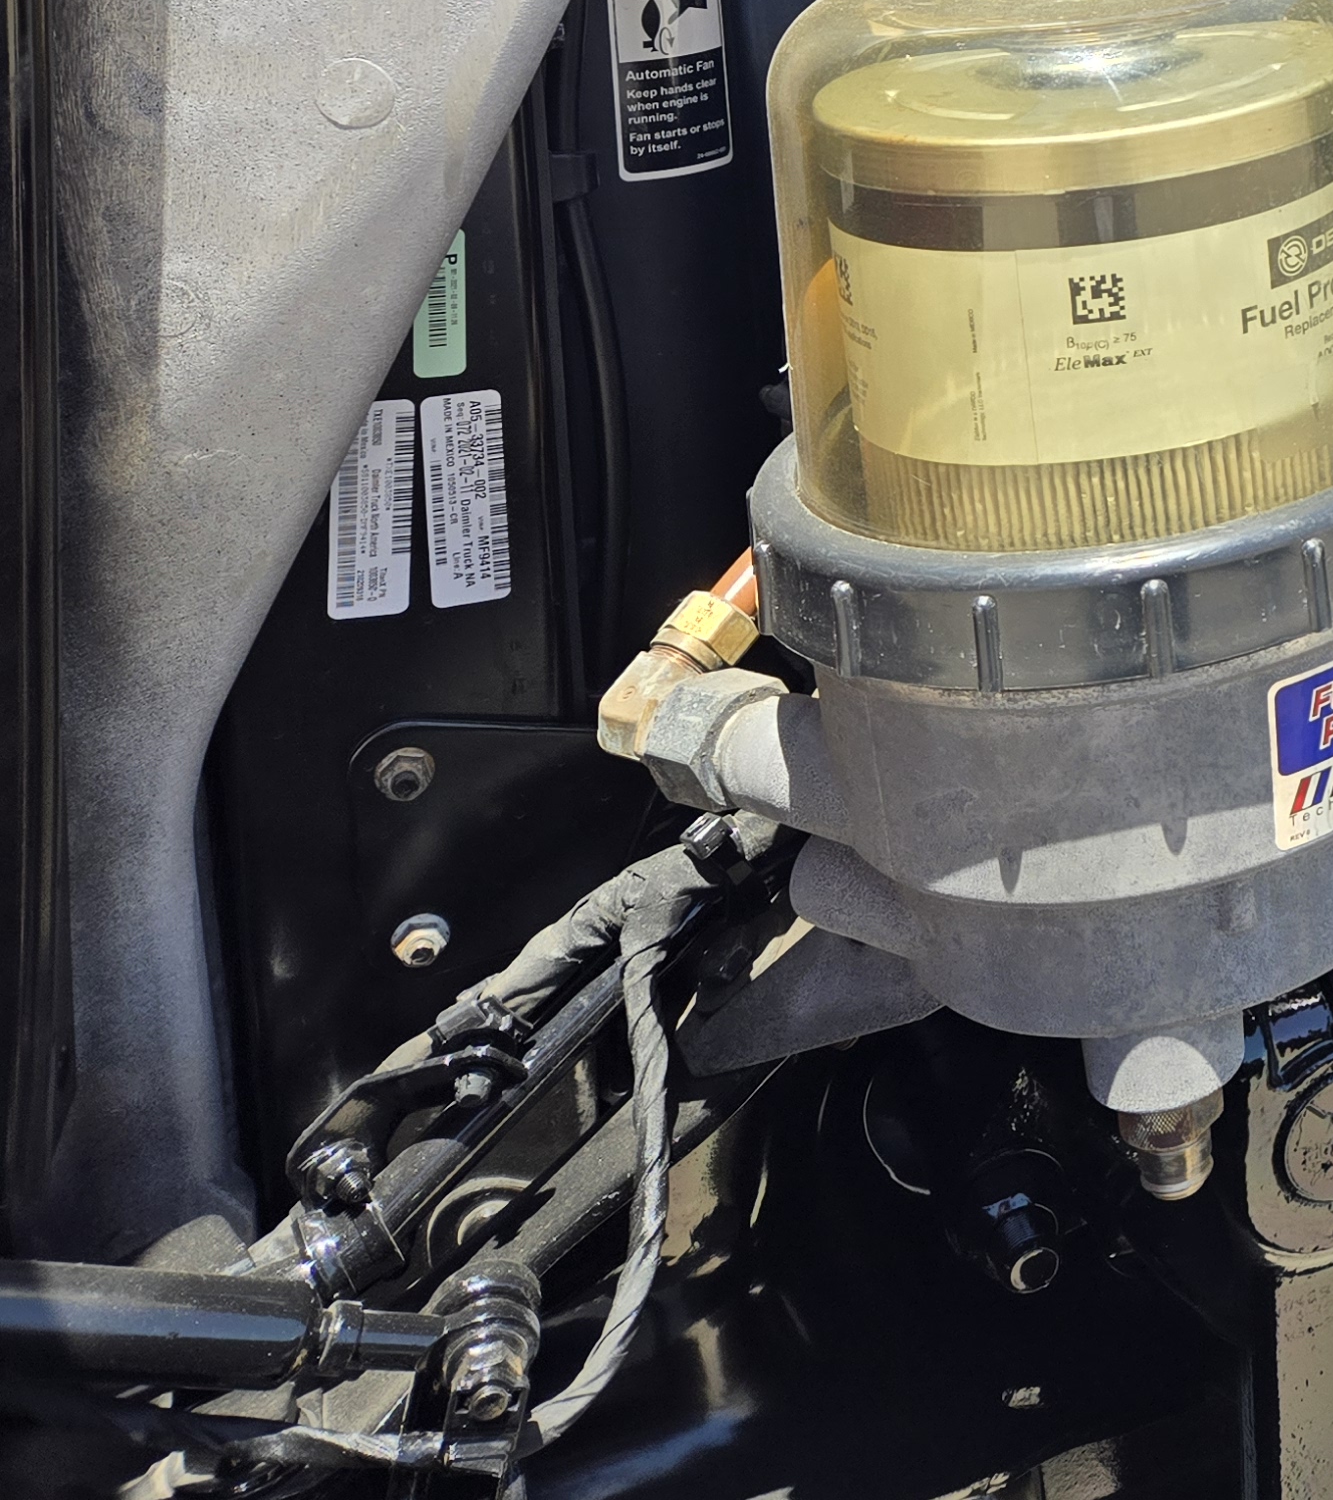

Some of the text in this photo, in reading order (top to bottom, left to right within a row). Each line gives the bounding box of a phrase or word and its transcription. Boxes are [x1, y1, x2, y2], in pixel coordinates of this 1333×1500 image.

[625, 59, 715, 83] Automatic Fan
[626, 77, 717, 101] Keep hands clear
[627, 92, 709, 113] when engine is
[628, 112, 678, 126] running.
[629, 117, 725, 143] Fan starts or stops
[630, 145, 645, 157] by
[647, 140, 682, 155] itself.
[1241, 290, 1300, 334] Fuel
[1123, 332, 1137, 343] 75
[1133, 348, 1153, 357] EXT
[443, 397, 455, 422] MADE
[444, 424, 455, 434] IN
[445, 435, 457, 467] MEXICO
[370, 468, 382, 493] Daimler
[460, 499, 474, 539] Daimler
[462, 541, 475, 570] Truck
[477, 535, 491, 580] MF9414
[464, 572, 477, 588] NA
